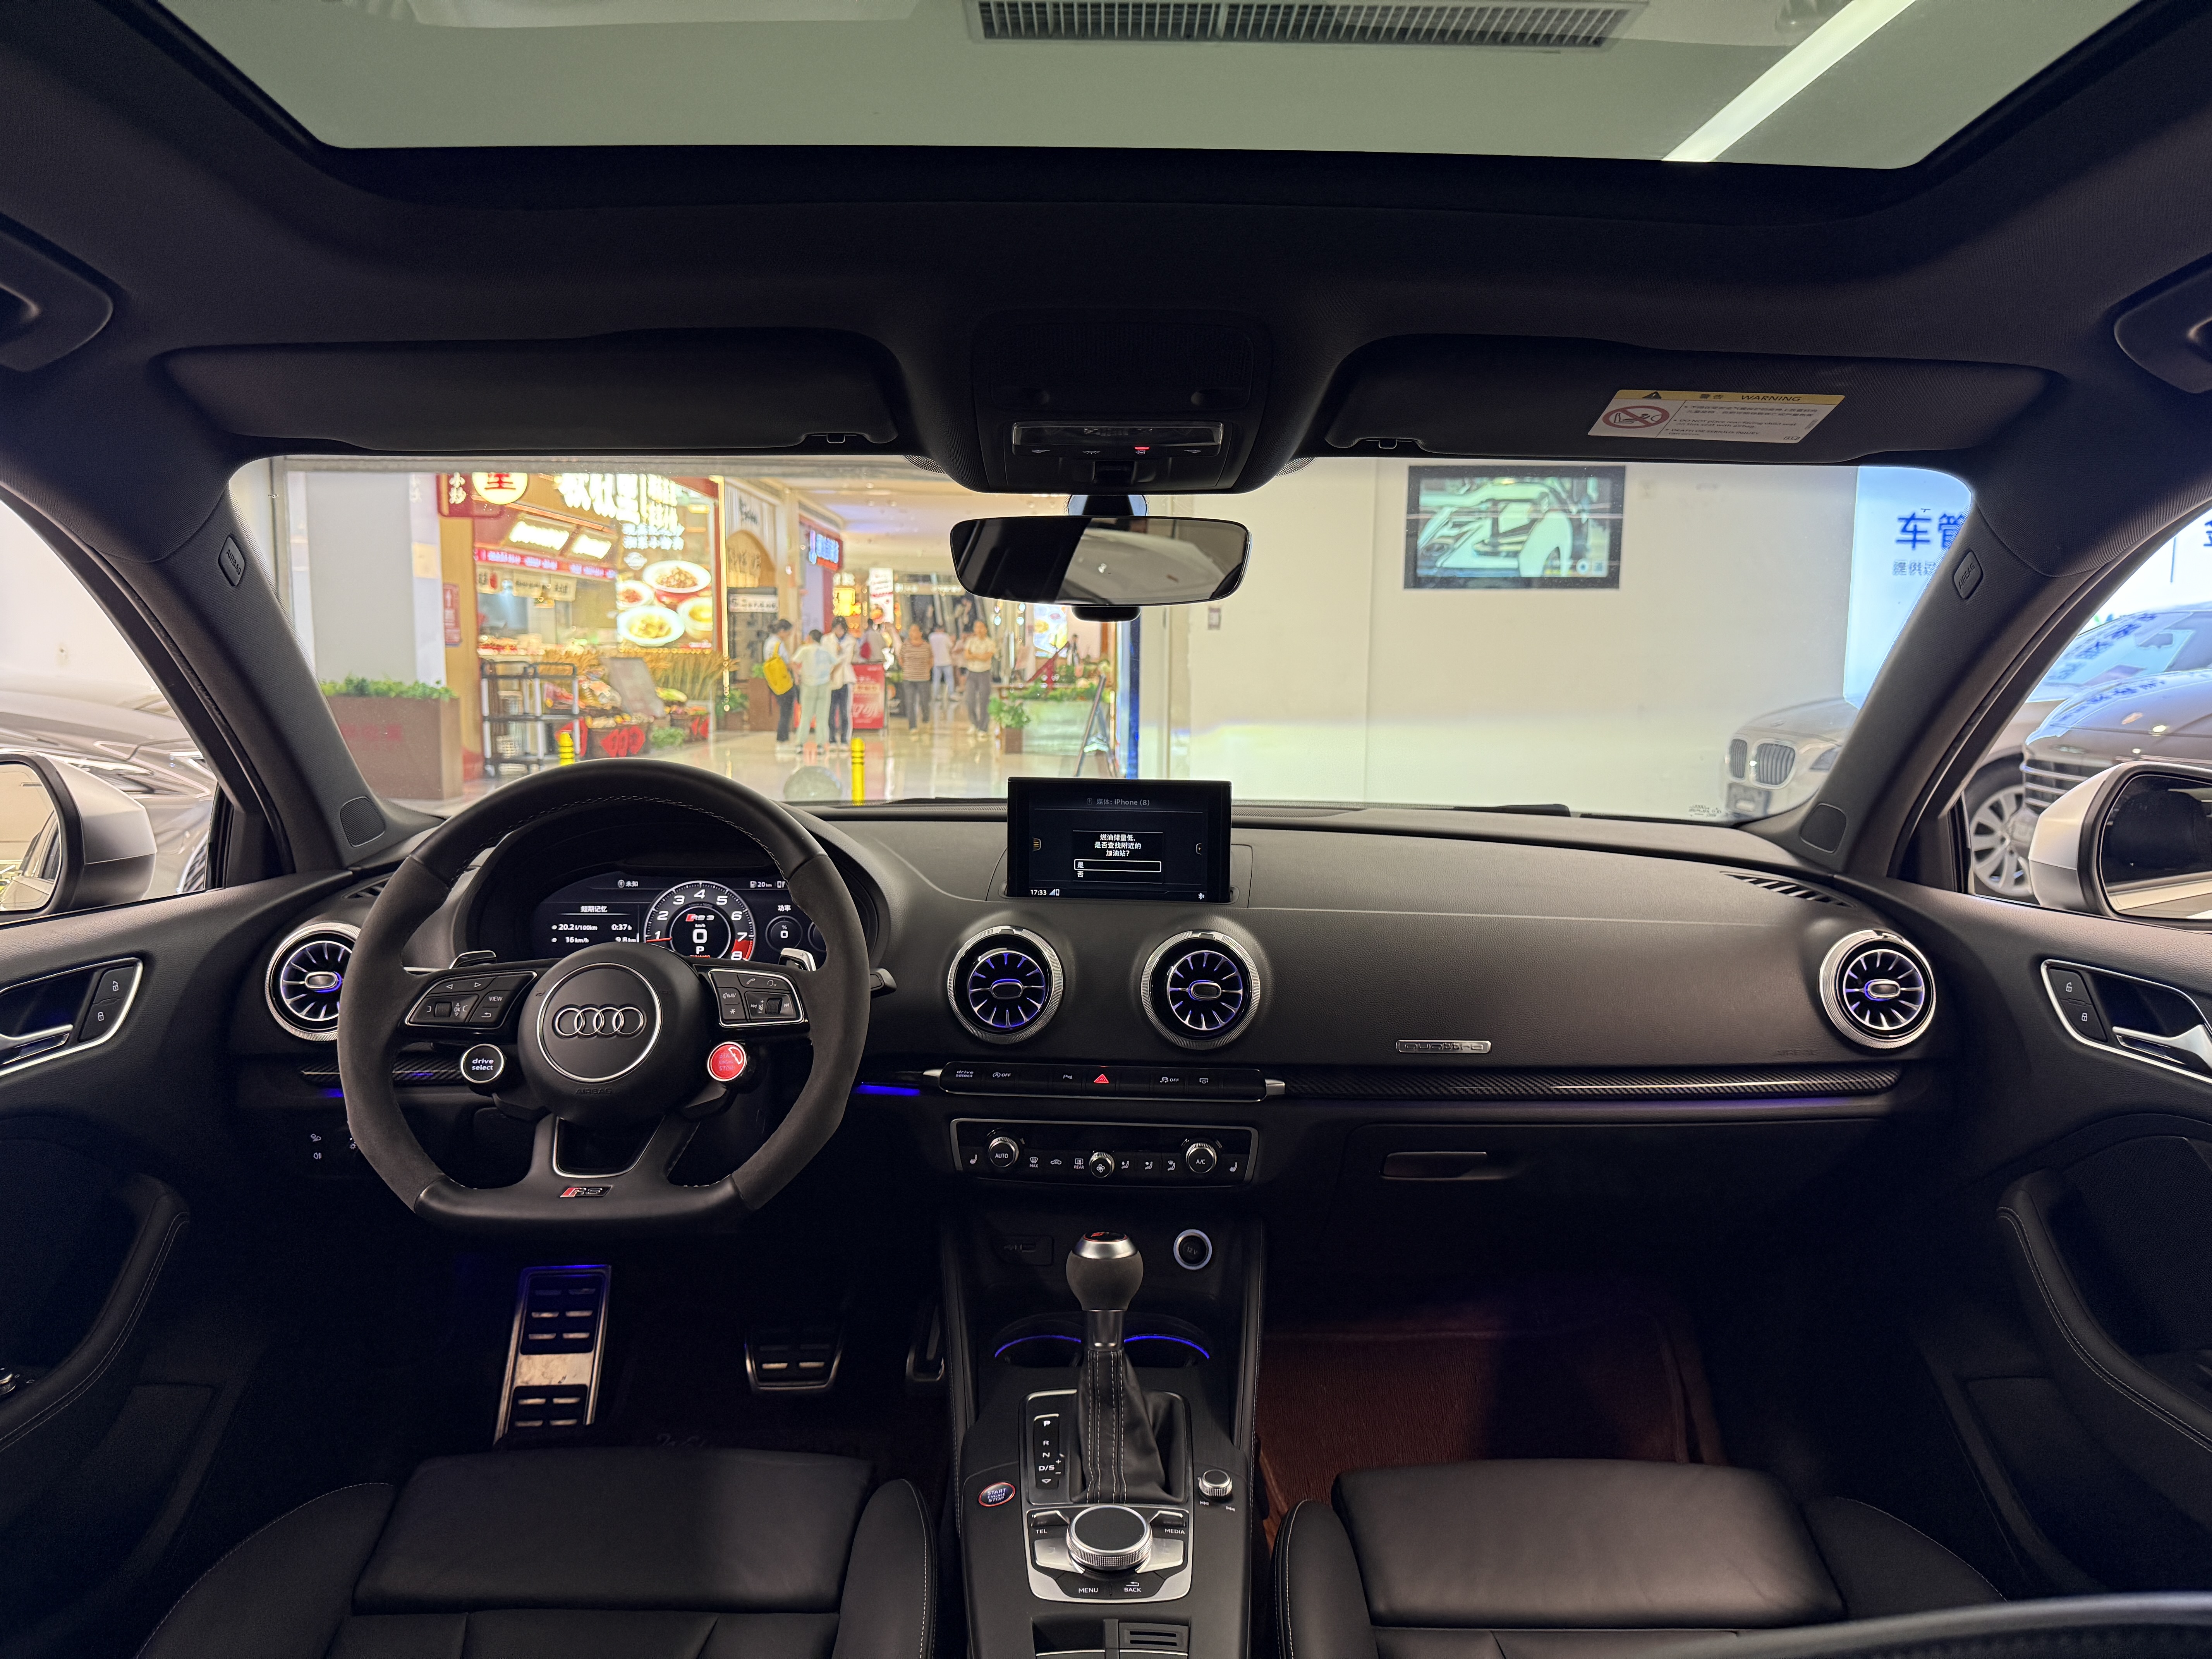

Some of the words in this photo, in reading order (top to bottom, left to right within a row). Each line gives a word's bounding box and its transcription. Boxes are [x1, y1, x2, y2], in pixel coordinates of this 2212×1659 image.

[227, 549, 241, 575] AIRBAG
[1958, 563, 1975, 589] AIRBAG
[1094, 841, 1142, 850] 是否查找附近的
[694, 889, 706, 899] 4
[673, 895, 685, 905] 3
[716, 895, 728, 905] 5
[657, 910, 669, 920] 2
[731, 911, 743, 921] 6
[654, 931, 661, 939] 1
[692, 928, 708, 944] 0
[737, 932, 748, 942] 7
[780, 930, 788, 939] 0
[696, 946, 705, 955] P
[731, 951, 743, 961] 8
